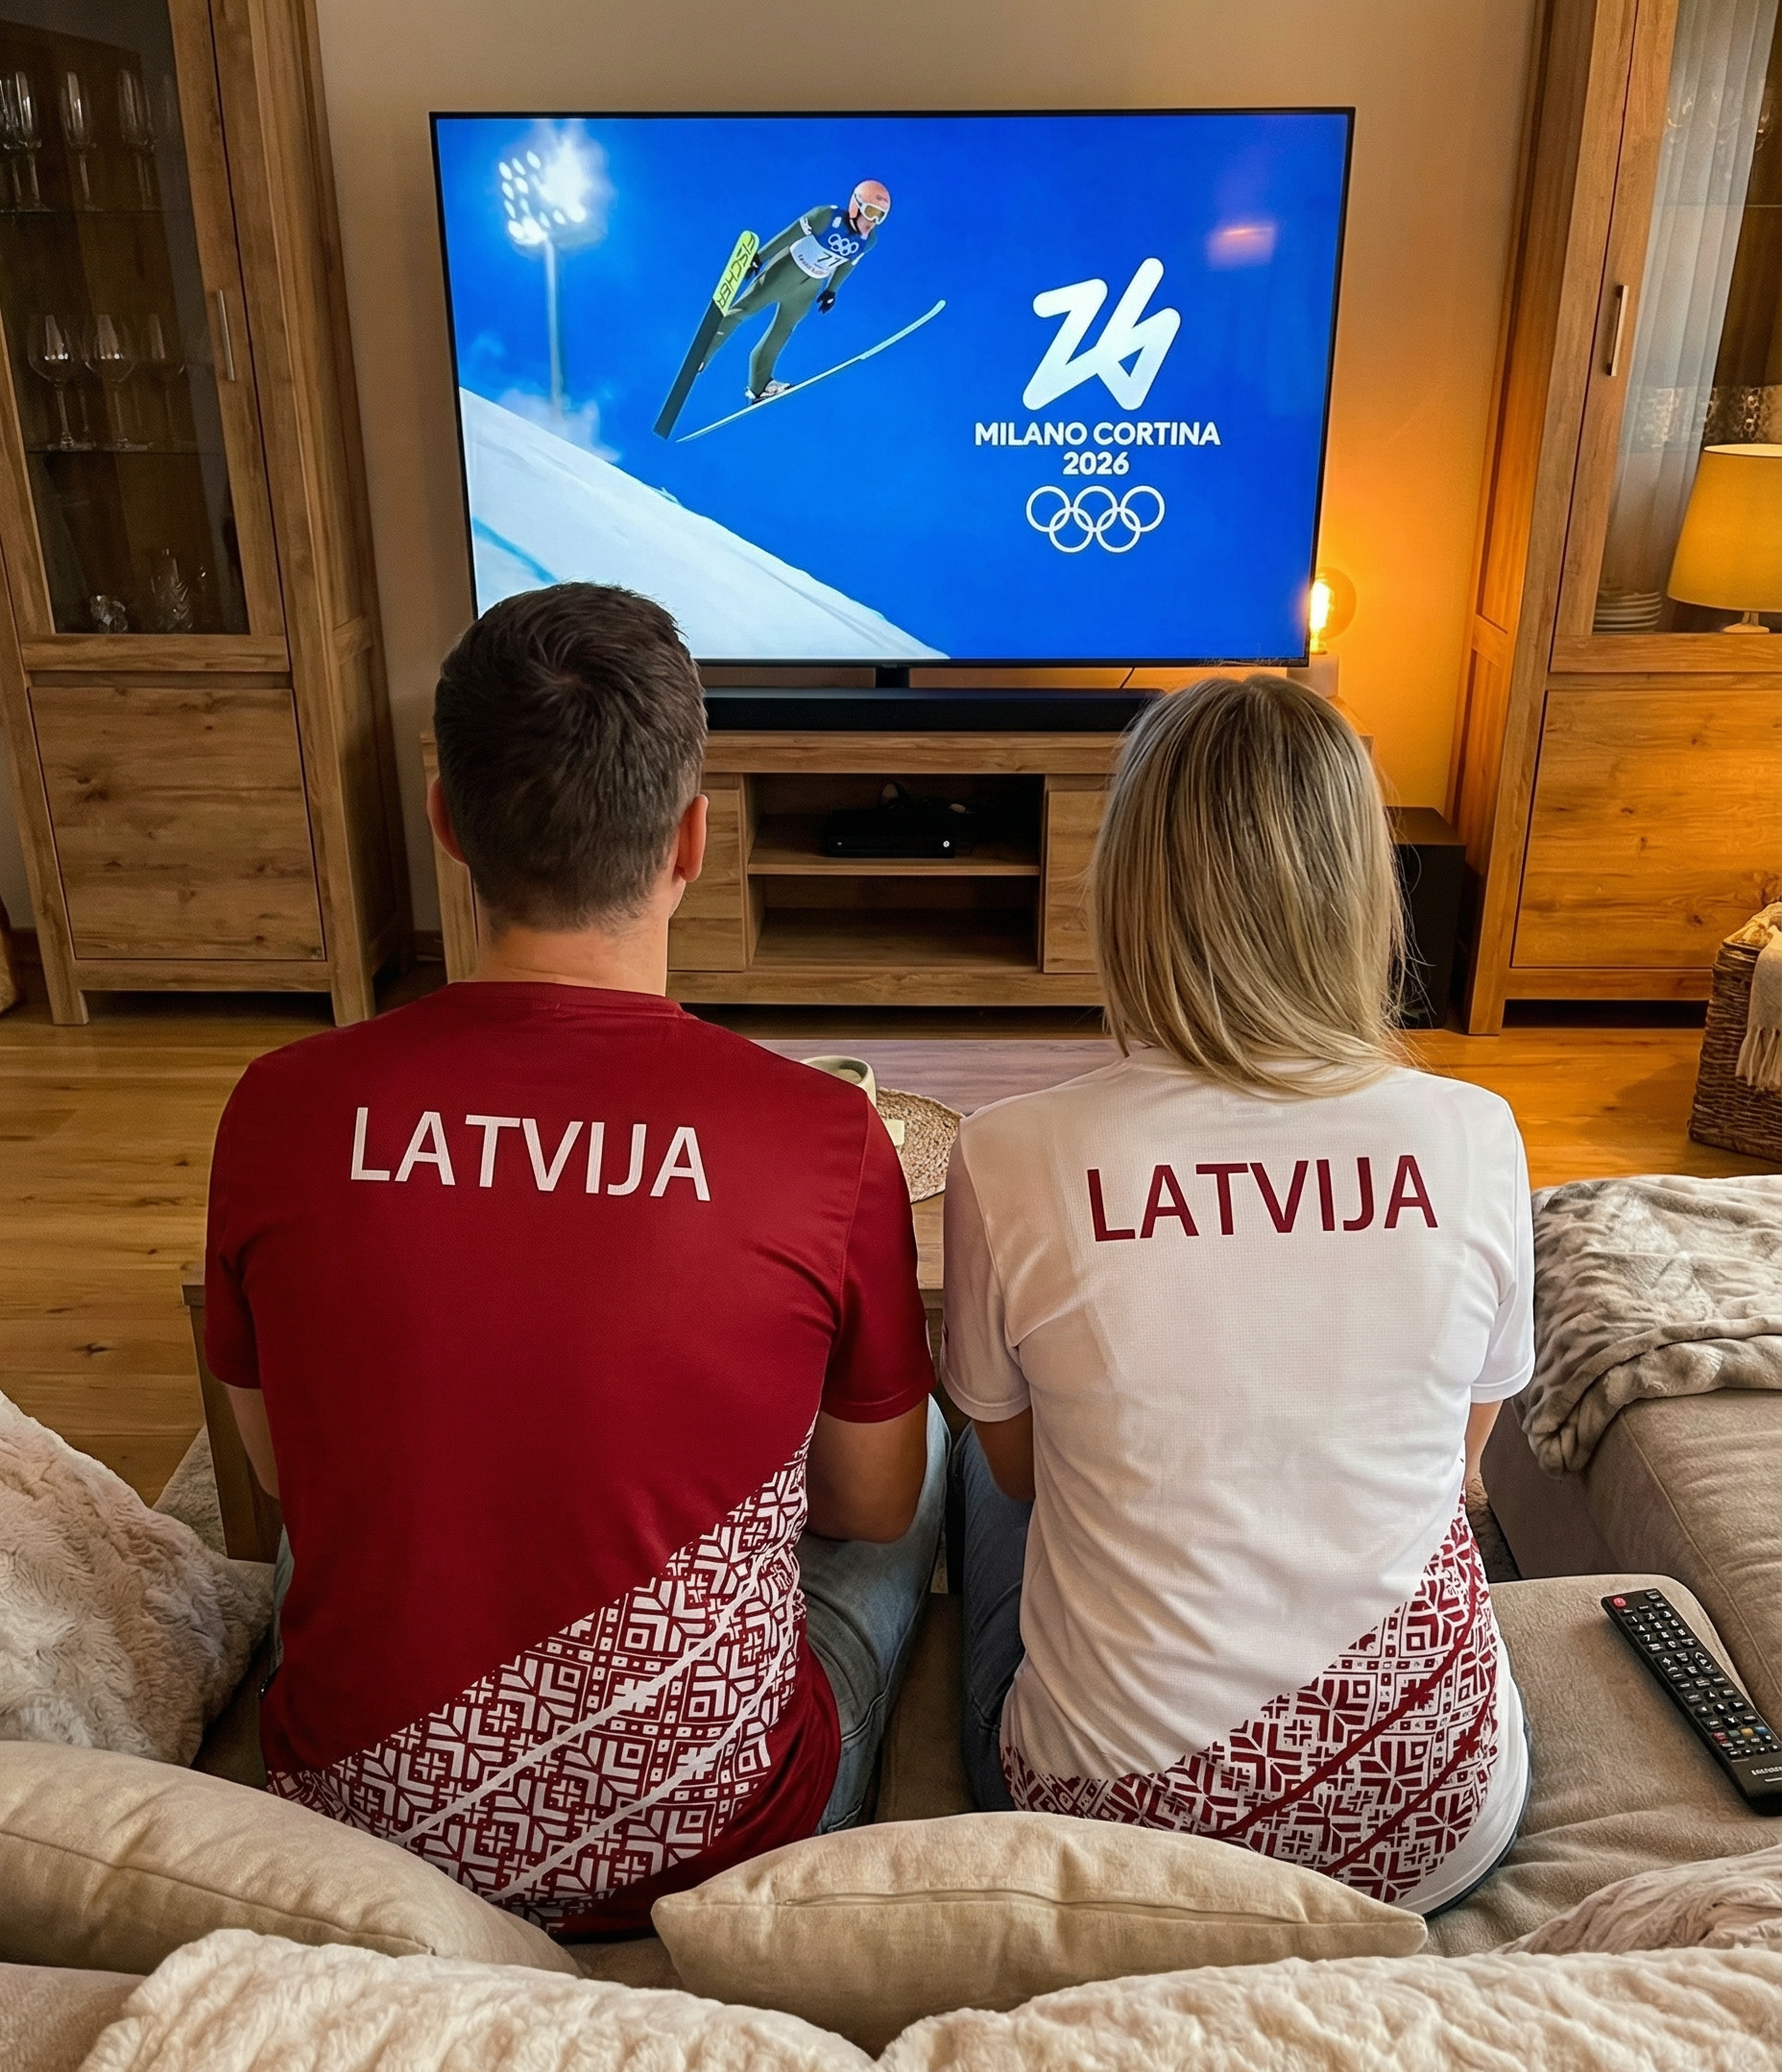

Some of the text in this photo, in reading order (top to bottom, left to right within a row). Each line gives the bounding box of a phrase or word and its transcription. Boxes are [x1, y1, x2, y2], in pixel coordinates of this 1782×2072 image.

[716, 232, 757, 309] FISCHER
[974, 421, 1221, 446] MILANO CORTINA
[1062, 450, 1130, 476] 2026
[349, 1106, 711, 1202] LATVIJA
[1086, 1154, 1439, 1242] LATVIJA
